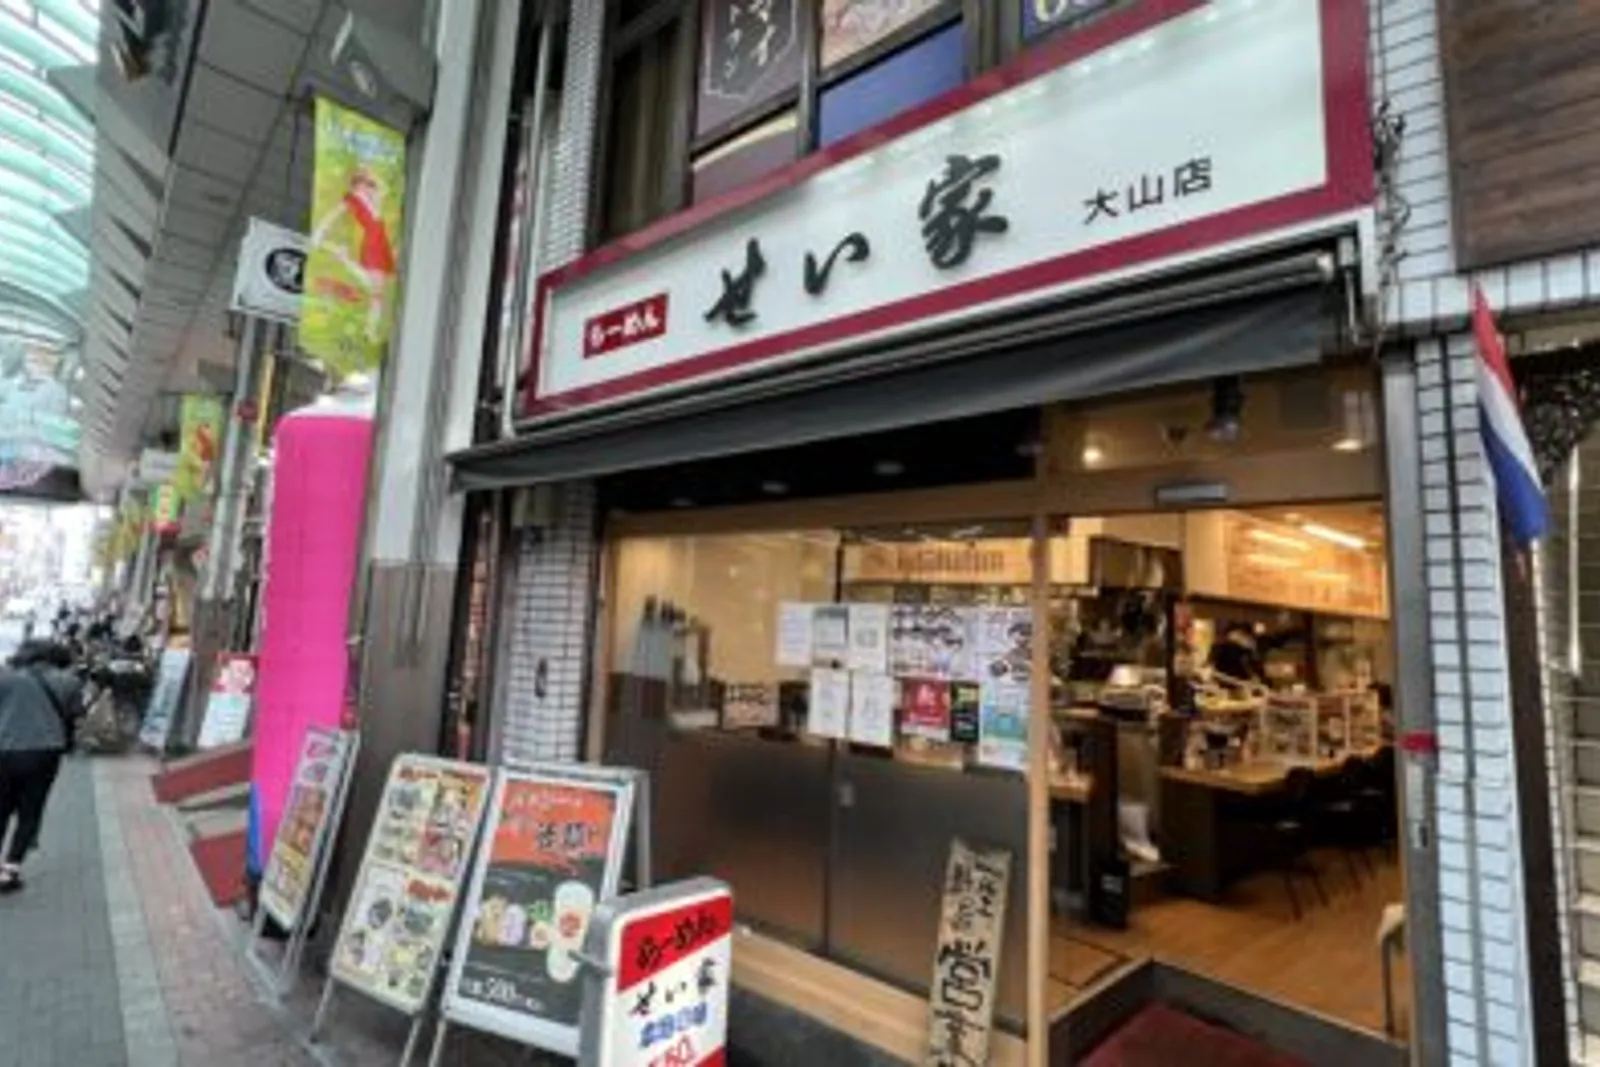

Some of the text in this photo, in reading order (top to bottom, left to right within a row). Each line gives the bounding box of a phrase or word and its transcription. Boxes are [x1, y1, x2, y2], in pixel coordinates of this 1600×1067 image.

[1082, 156, 1213, 225] 大山店
[703, 154, 1008, 328] せい家
[590, 304, 660, 348] らーめん
